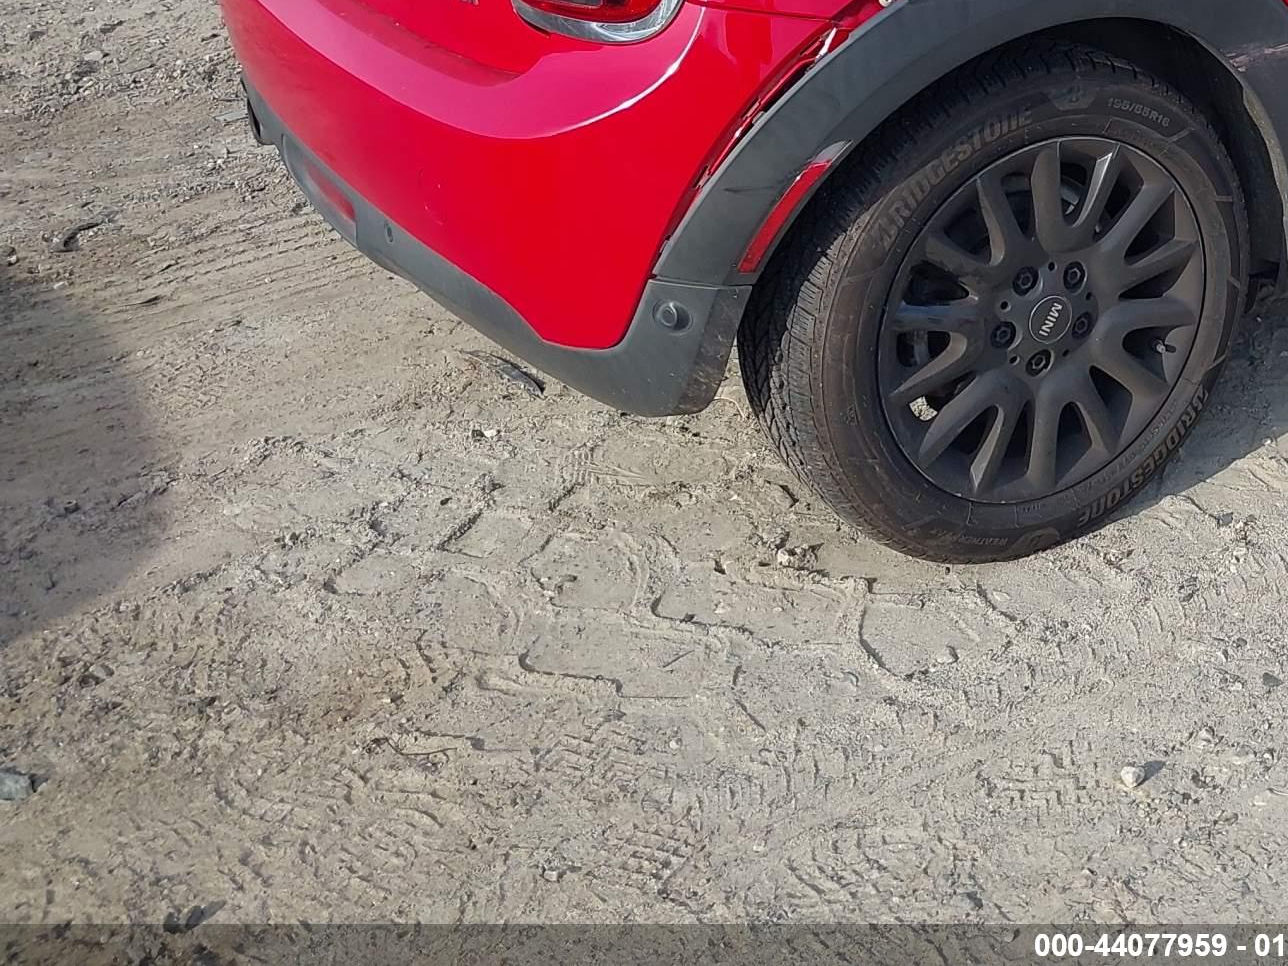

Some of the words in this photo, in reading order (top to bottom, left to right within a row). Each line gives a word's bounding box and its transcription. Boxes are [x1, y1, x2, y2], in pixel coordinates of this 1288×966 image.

[872, 104, 1033, 252] BRIDGESTONE
[1038, 302, 1063, 336] MINI
[1077, 384, 1210, 528] BRIDGESTONE
